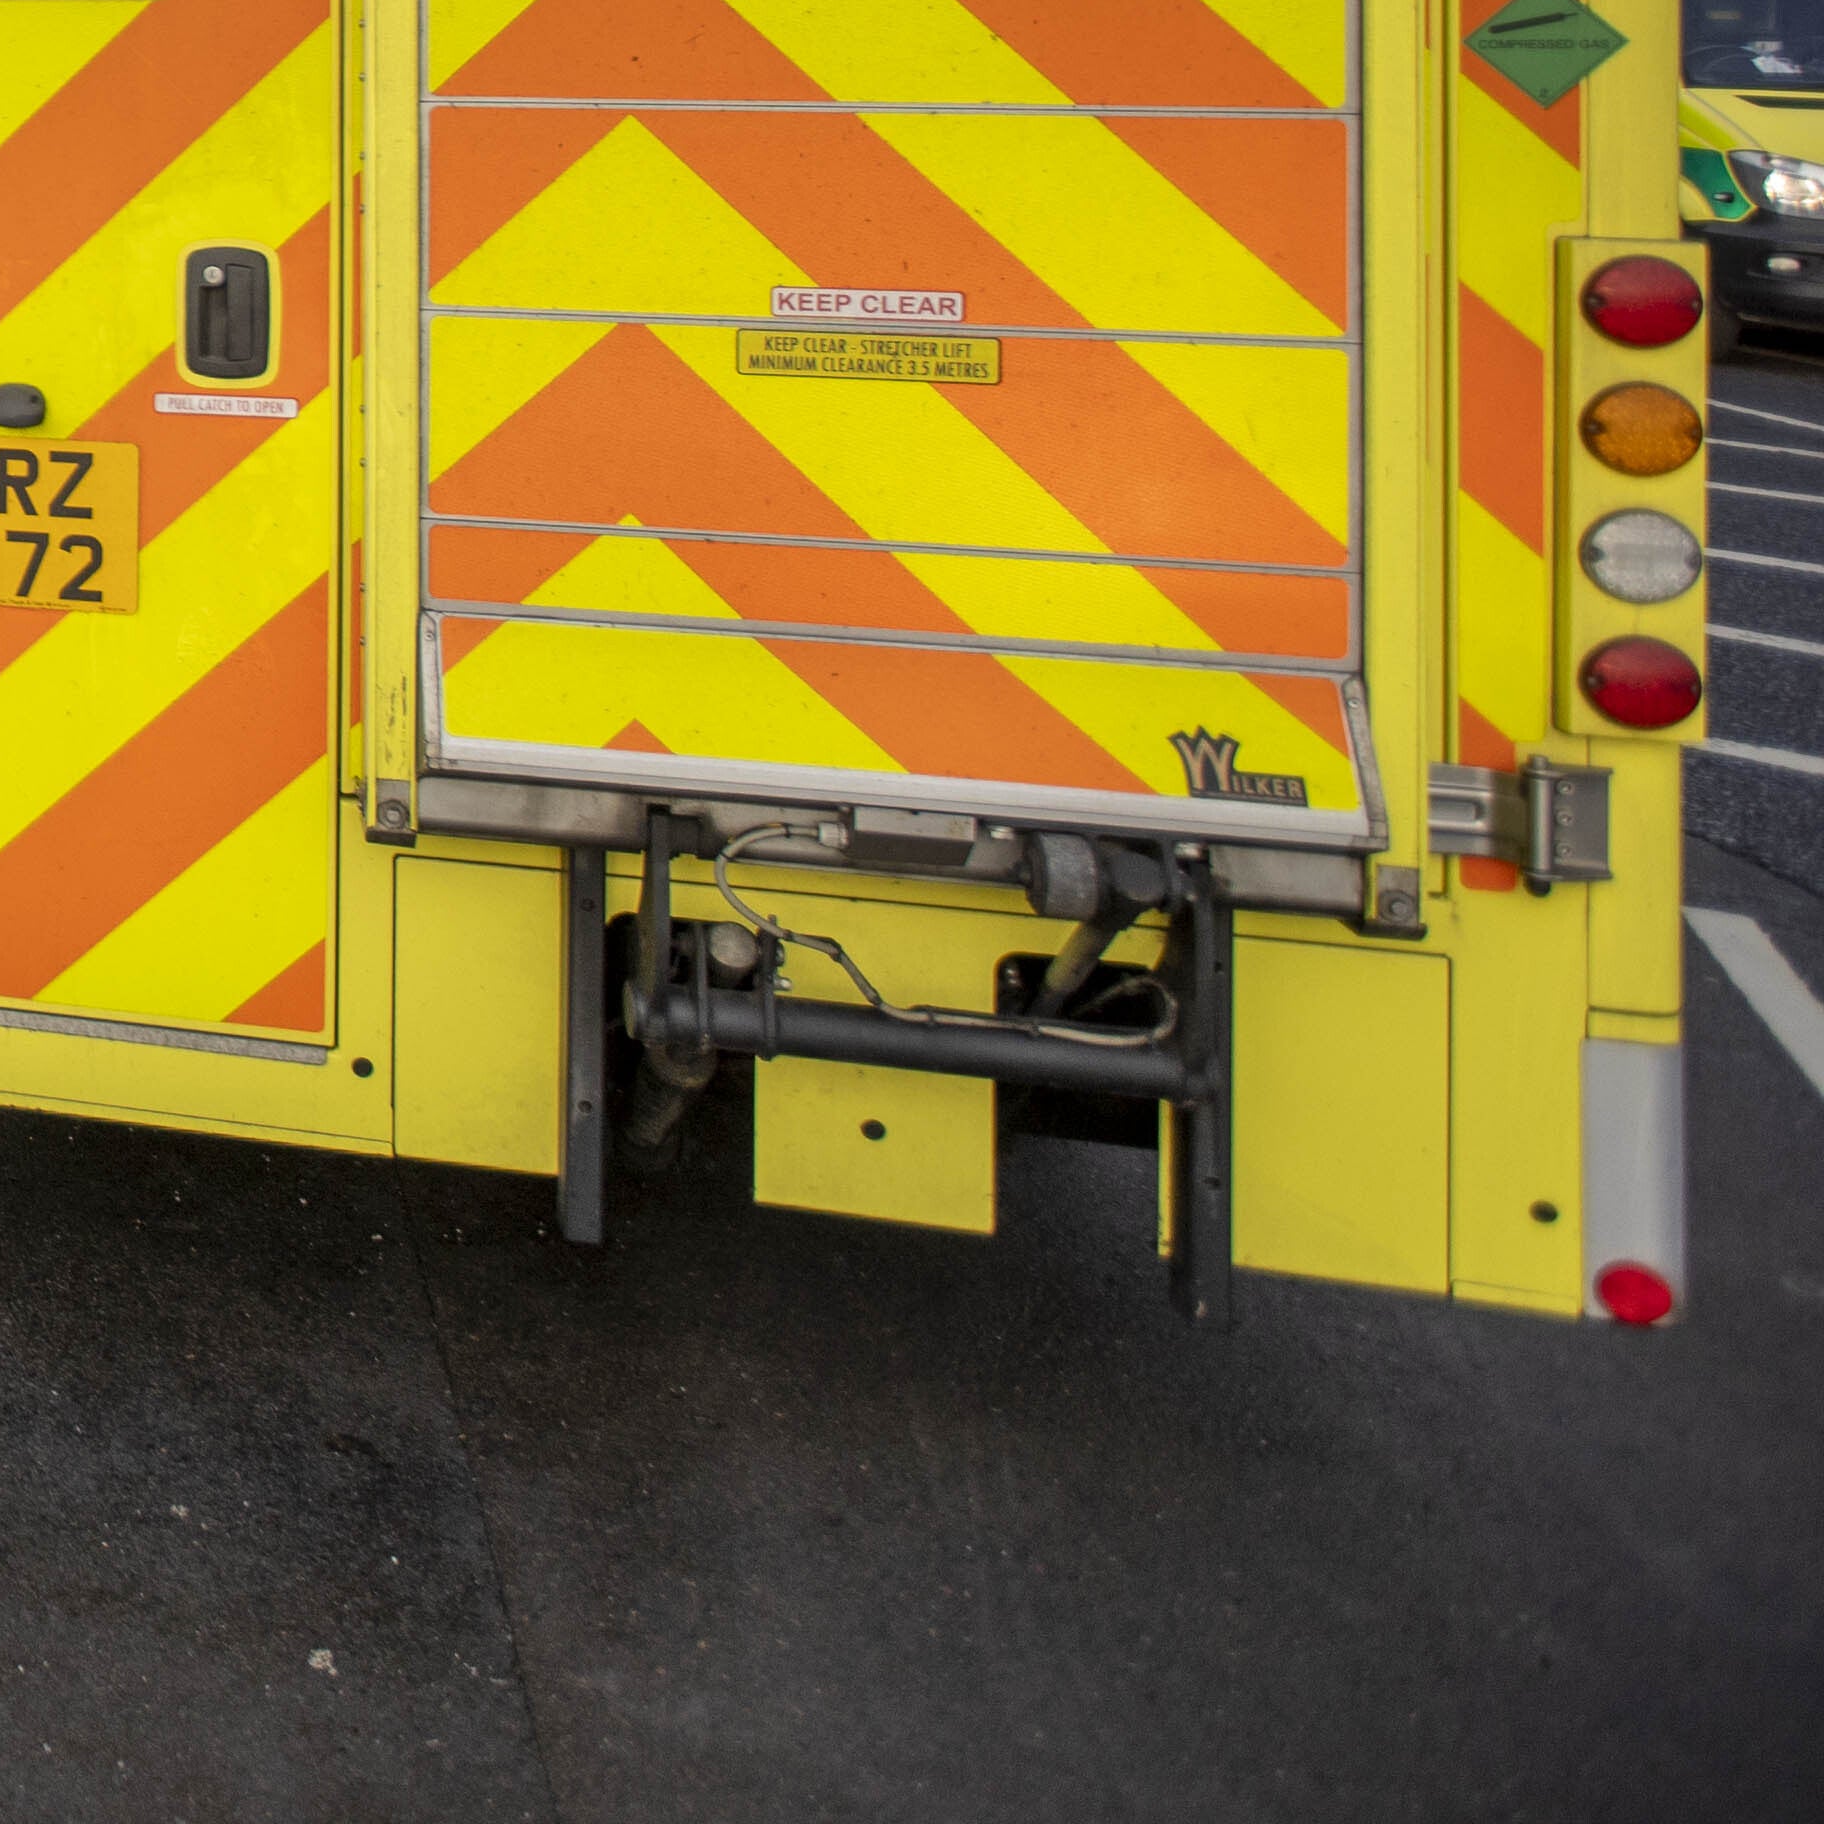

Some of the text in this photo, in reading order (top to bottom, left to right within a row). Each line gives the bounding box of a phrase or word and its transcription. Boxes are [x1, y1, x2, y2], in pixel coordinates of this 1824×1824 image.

[1478, 39, 1610, 49] COMPRESSED GAS
[777, 292, 957, 316] KEEP CLEAR
[764, 336, 798, 352] KEEP
[803, 338, 847, 353] CLEAR
[860, 340, 938, 357] STRETCHER
[943, 343, 972, 358] LIFT
[749, 355, 989, 379] MINIMUM CLEARANCE 3.5 METRES
[167, 397, 284, 414] PULL CATCH TO OPEN
[1175, 736, 1302, 798] WILKER
